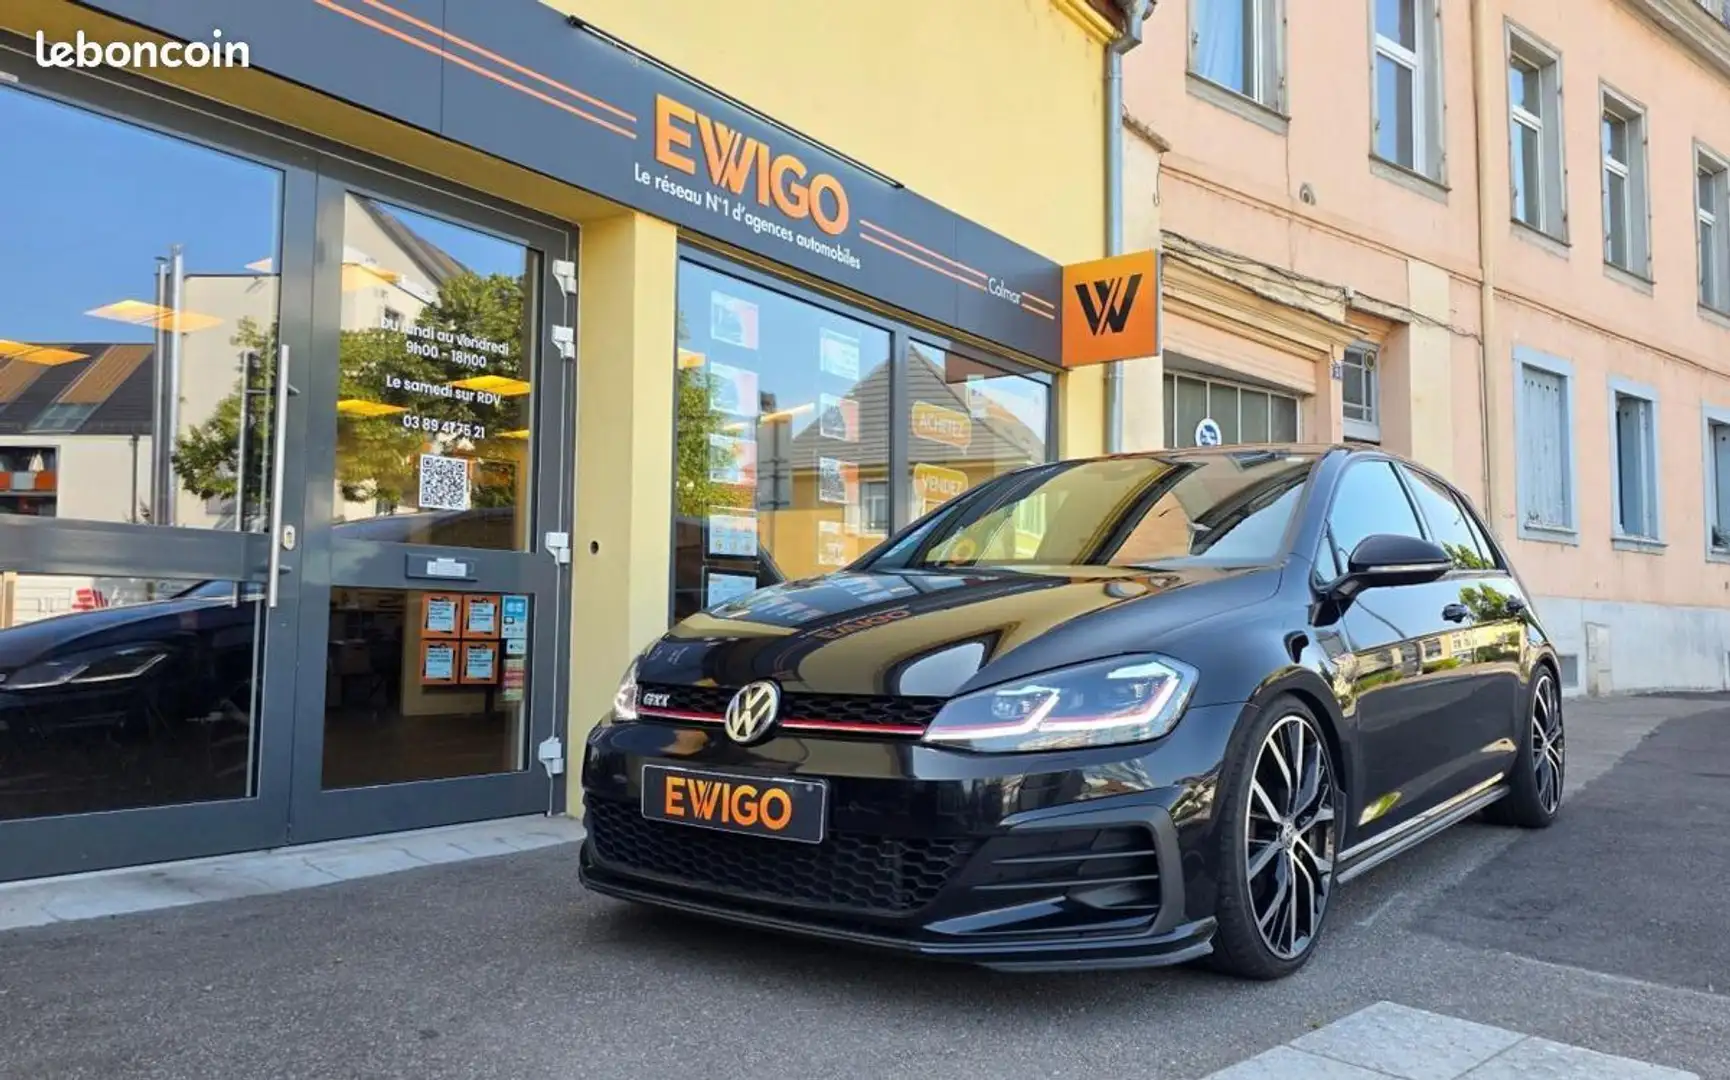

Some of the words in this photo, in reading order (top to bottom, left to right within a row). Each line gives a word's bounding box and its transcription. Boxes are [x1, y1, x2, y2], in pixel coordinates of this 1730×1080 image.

[655, 93, 850, 236] EWIGO
[634, 162, 650, 185] Le
[655, 175, 702, 206] réseau
[732, 203, 794, 243] d'agences
[796, 233, 861, 270] automobiles
[988, 277, 1021, 305] Colmar
[402, 321, 434, 340] undi
[436, 330, 454, 343] au
[406, 340, 439, 359] 9h00
[451, 349, 487, 368] 18h00
[386, 375, 401, 389] Le
[403, 379, 453, 398] samedi
[455, 389, 475, 401] sur
[477, 391, 501, 405] RDV
[403, 414, 420, 429] 03
[422, 417, 439, 432] 89
[473, 425, 485, 439] 21
[664, 775, 793, 831] EWIGO
